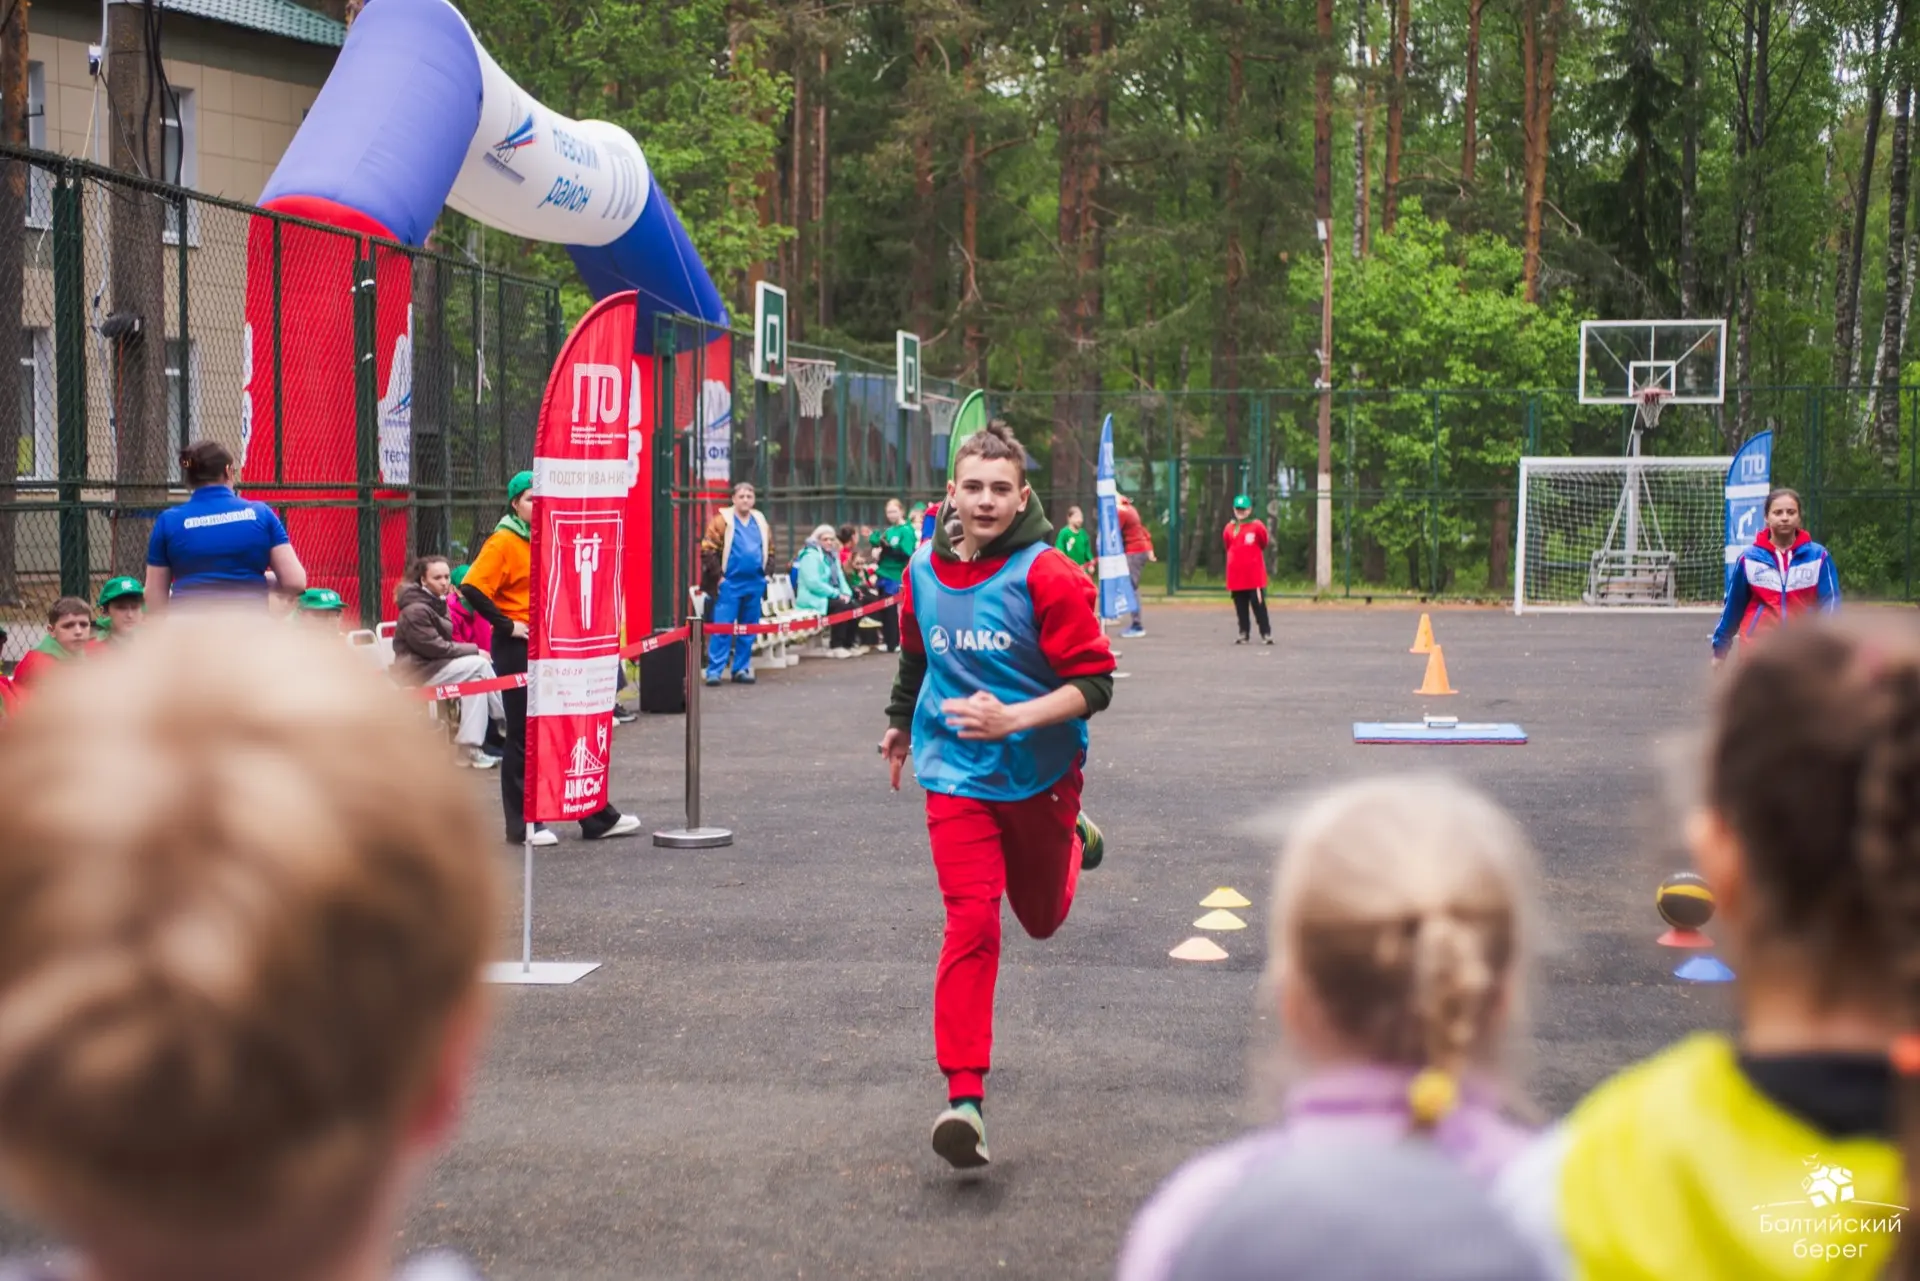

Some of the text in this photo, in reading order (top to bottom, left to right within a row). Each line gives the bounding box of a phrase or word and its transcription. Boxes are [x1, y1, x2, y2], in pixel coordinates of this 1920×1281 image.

[537, 173, 593, 214] район
[549, 470, 625, 486] ПОДТЯГИВАНИЕ
[955, 628, 1012, 651] JAKO
